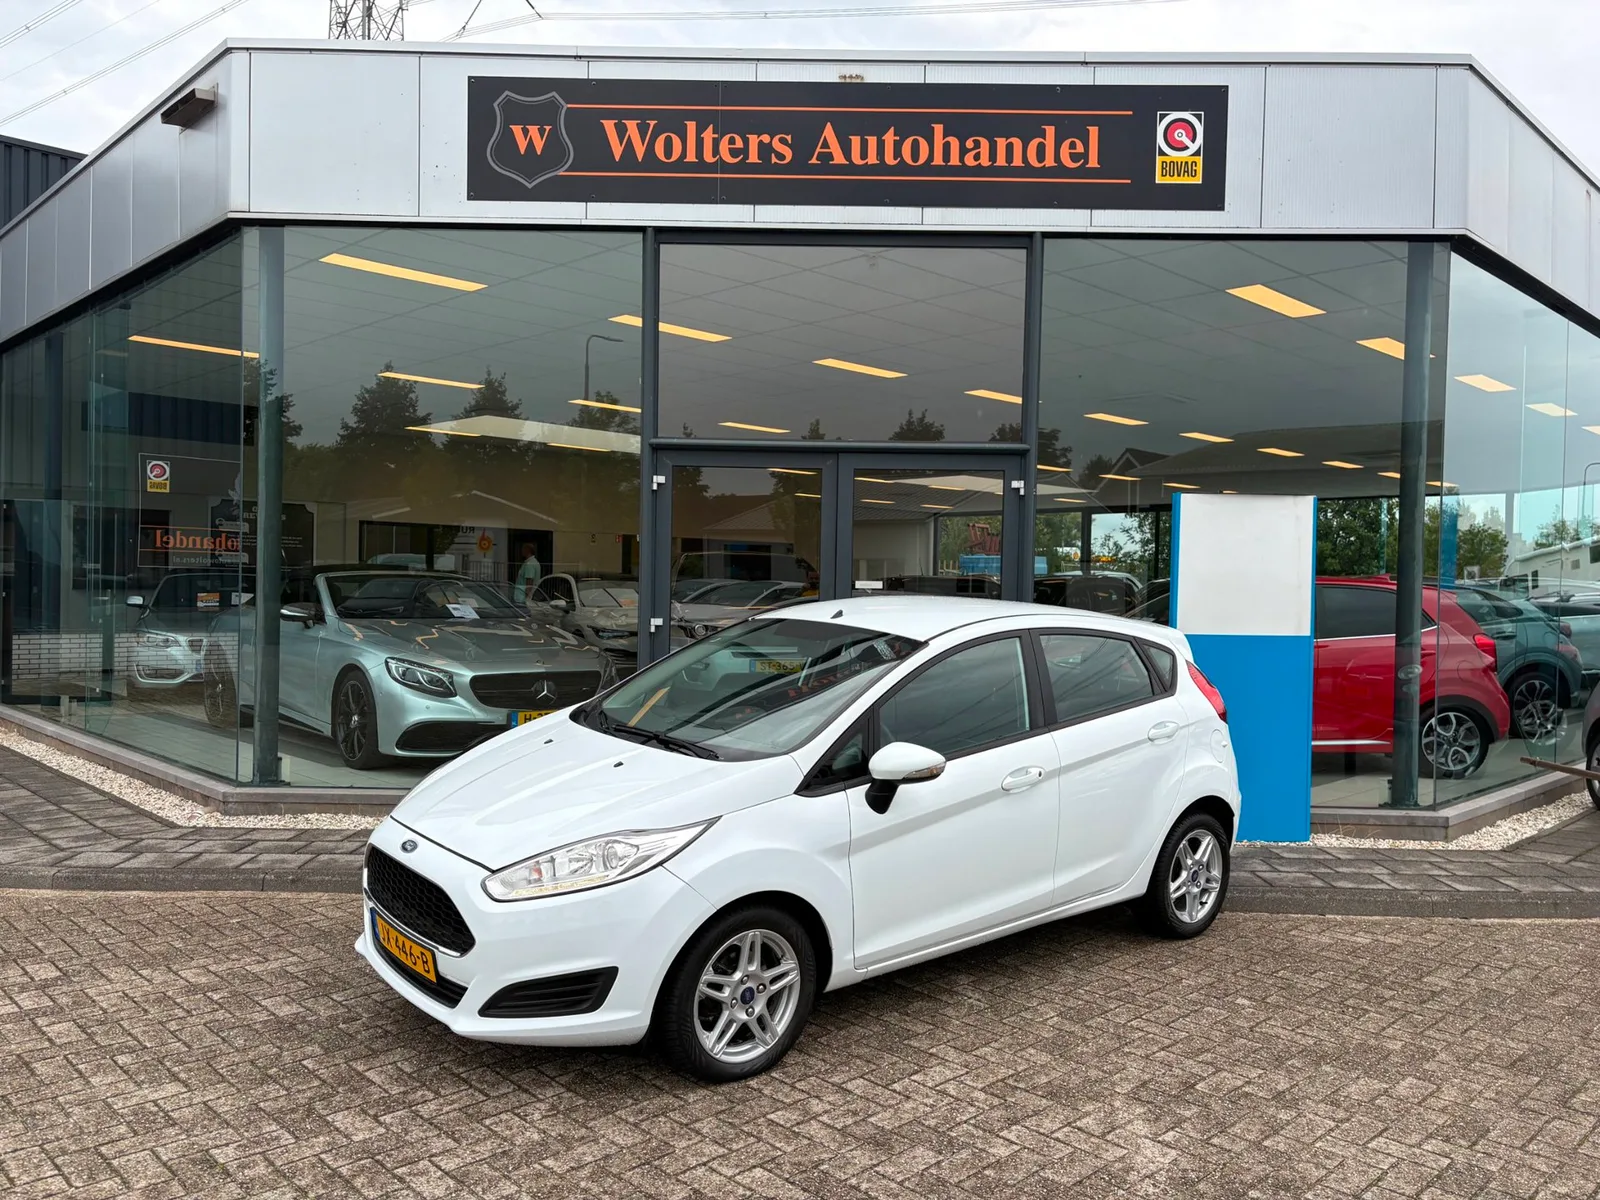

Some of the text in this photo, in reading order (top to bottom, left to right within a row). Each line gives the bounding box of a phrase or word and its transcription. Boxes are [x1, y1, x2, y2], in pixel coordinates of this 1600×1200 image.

[509, 124, 552, 156] W
[599, 119, 1102, 168] Wolters Autohandel
[1161, 160, 1198, 178] BOVAG
[381, 922, 430, 974] JX-446-B
